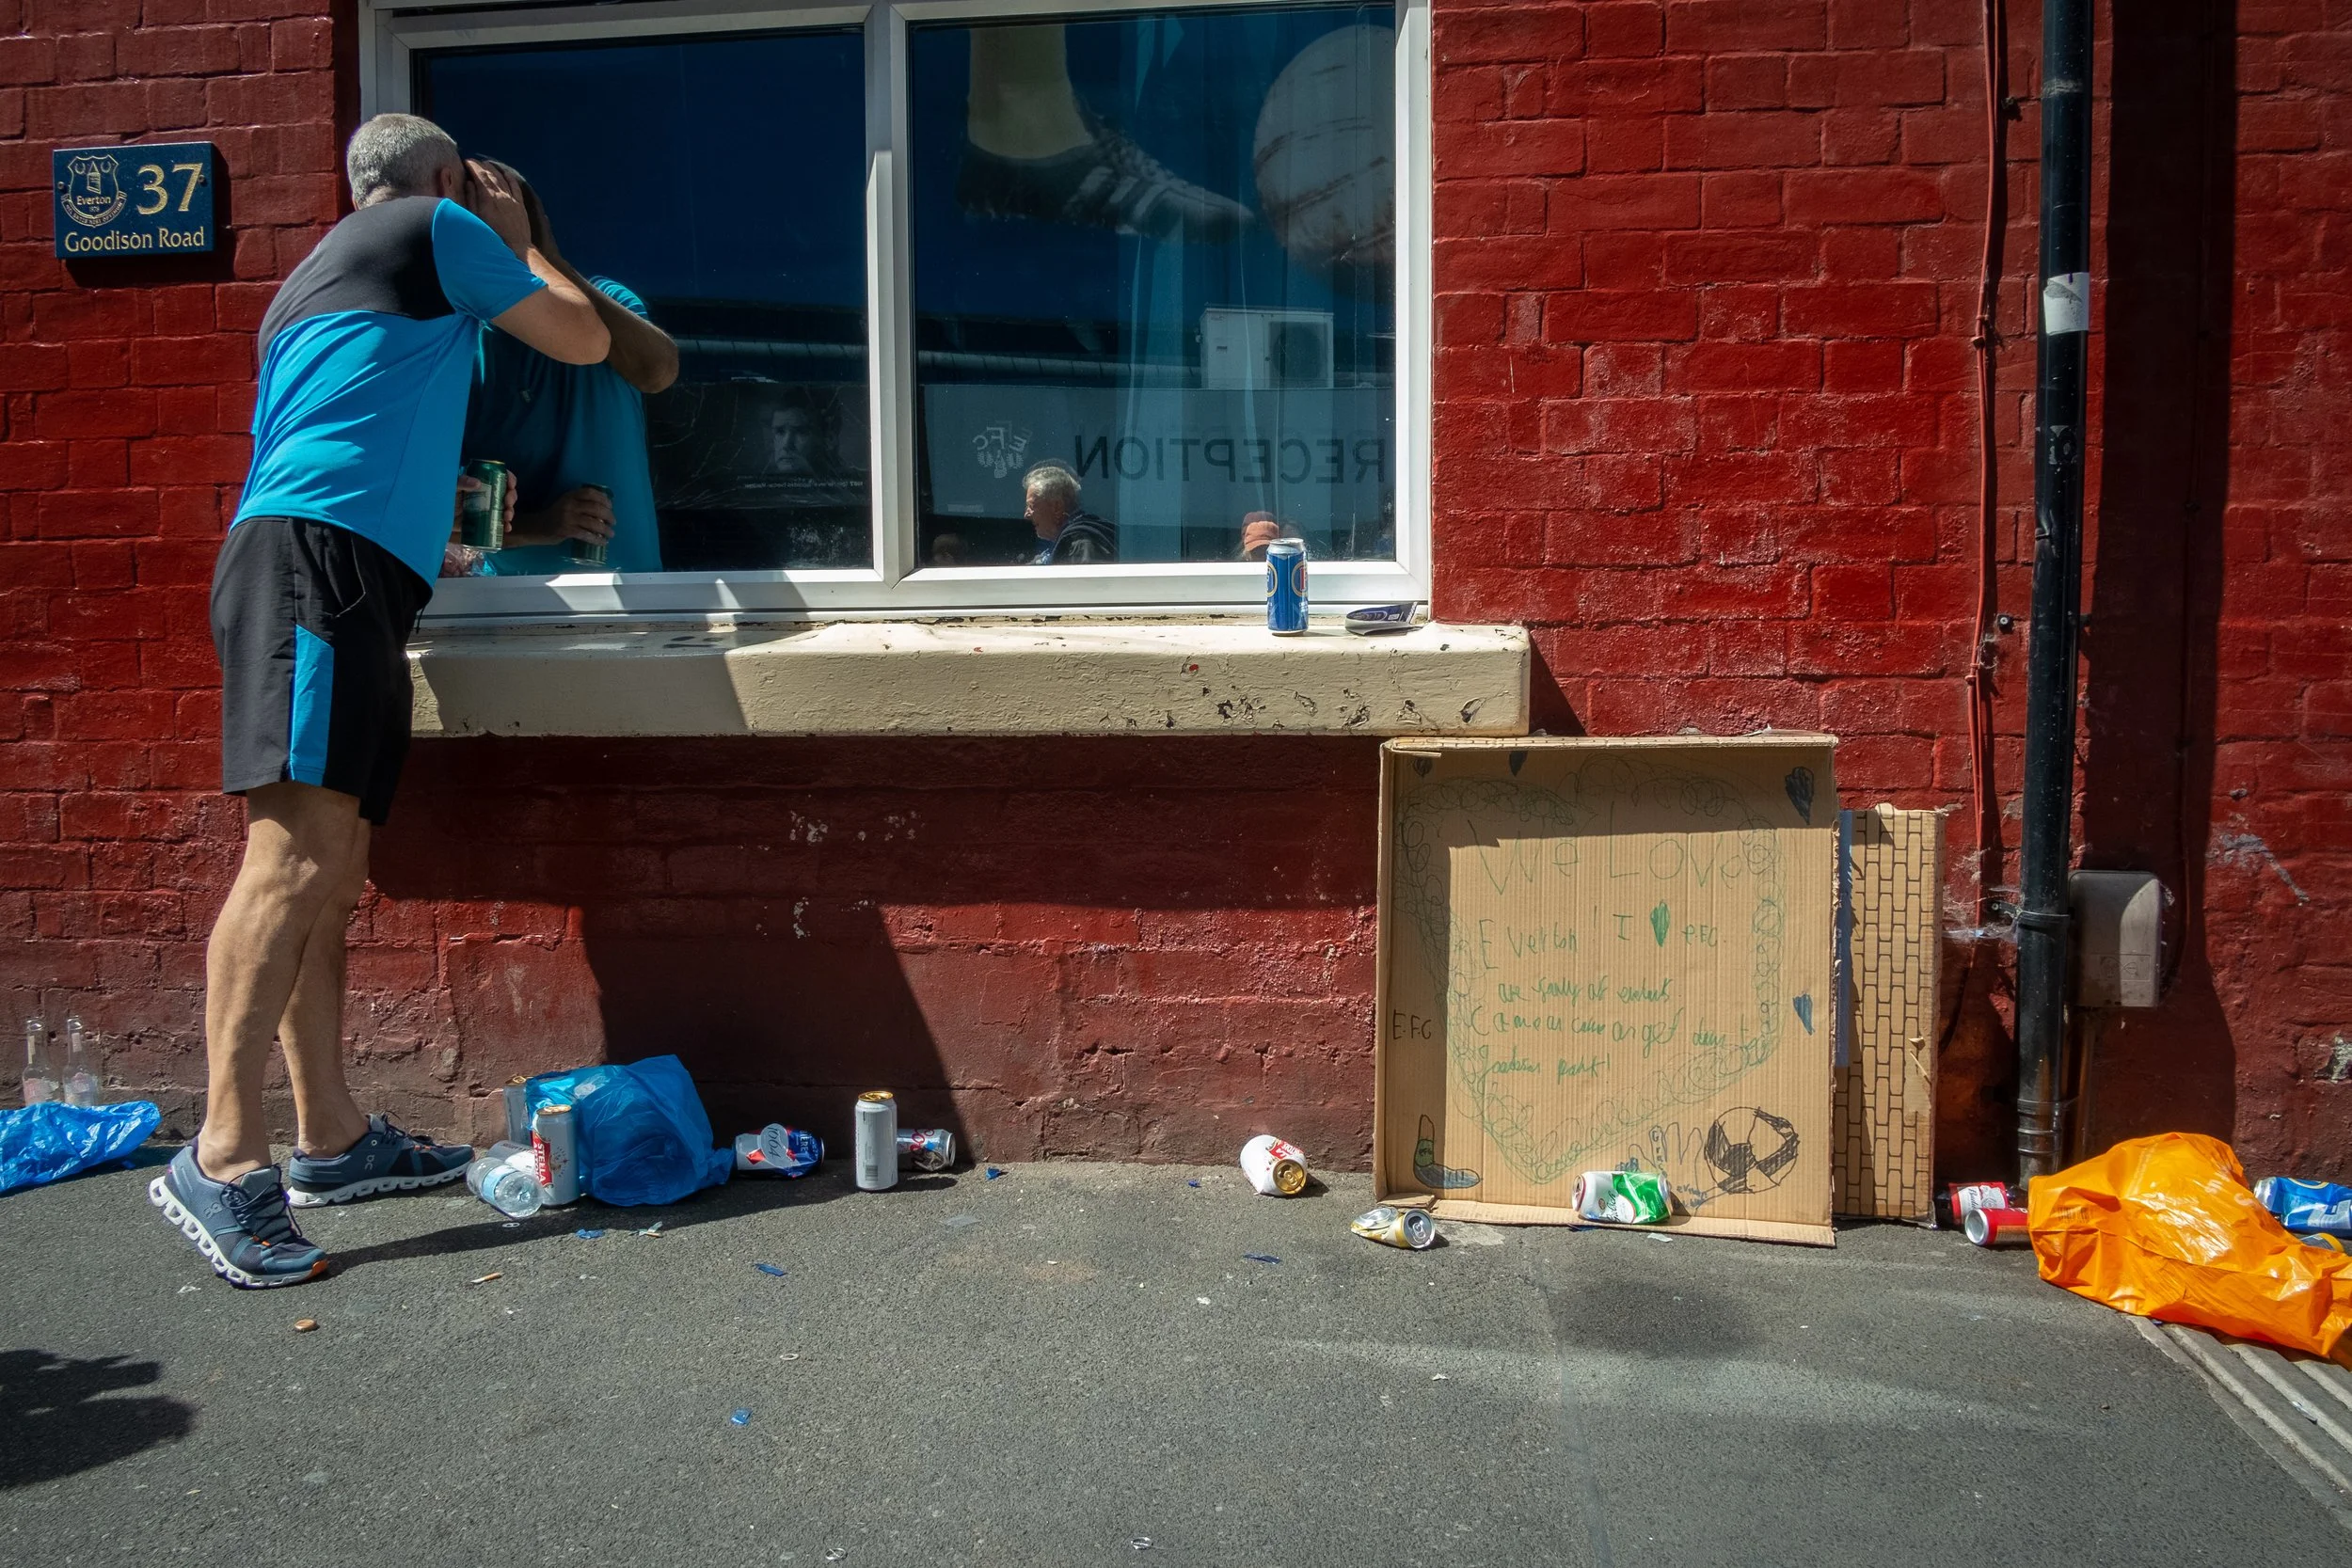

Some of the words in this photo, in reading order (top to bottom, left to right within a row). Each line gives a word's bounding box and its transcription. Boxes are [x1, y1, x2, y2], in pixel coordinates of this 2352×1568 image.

[76, 195, 111, 205] Everton
[135, 162, 203, 215] 37
[65, 230, 153, 252] Goodison
[158, 226, 204, 248] Road
[1468, 816, 1579, 895] We
[1613, 912, 1634, 941] I
[537, 1143, 548, 1183] STELLA
